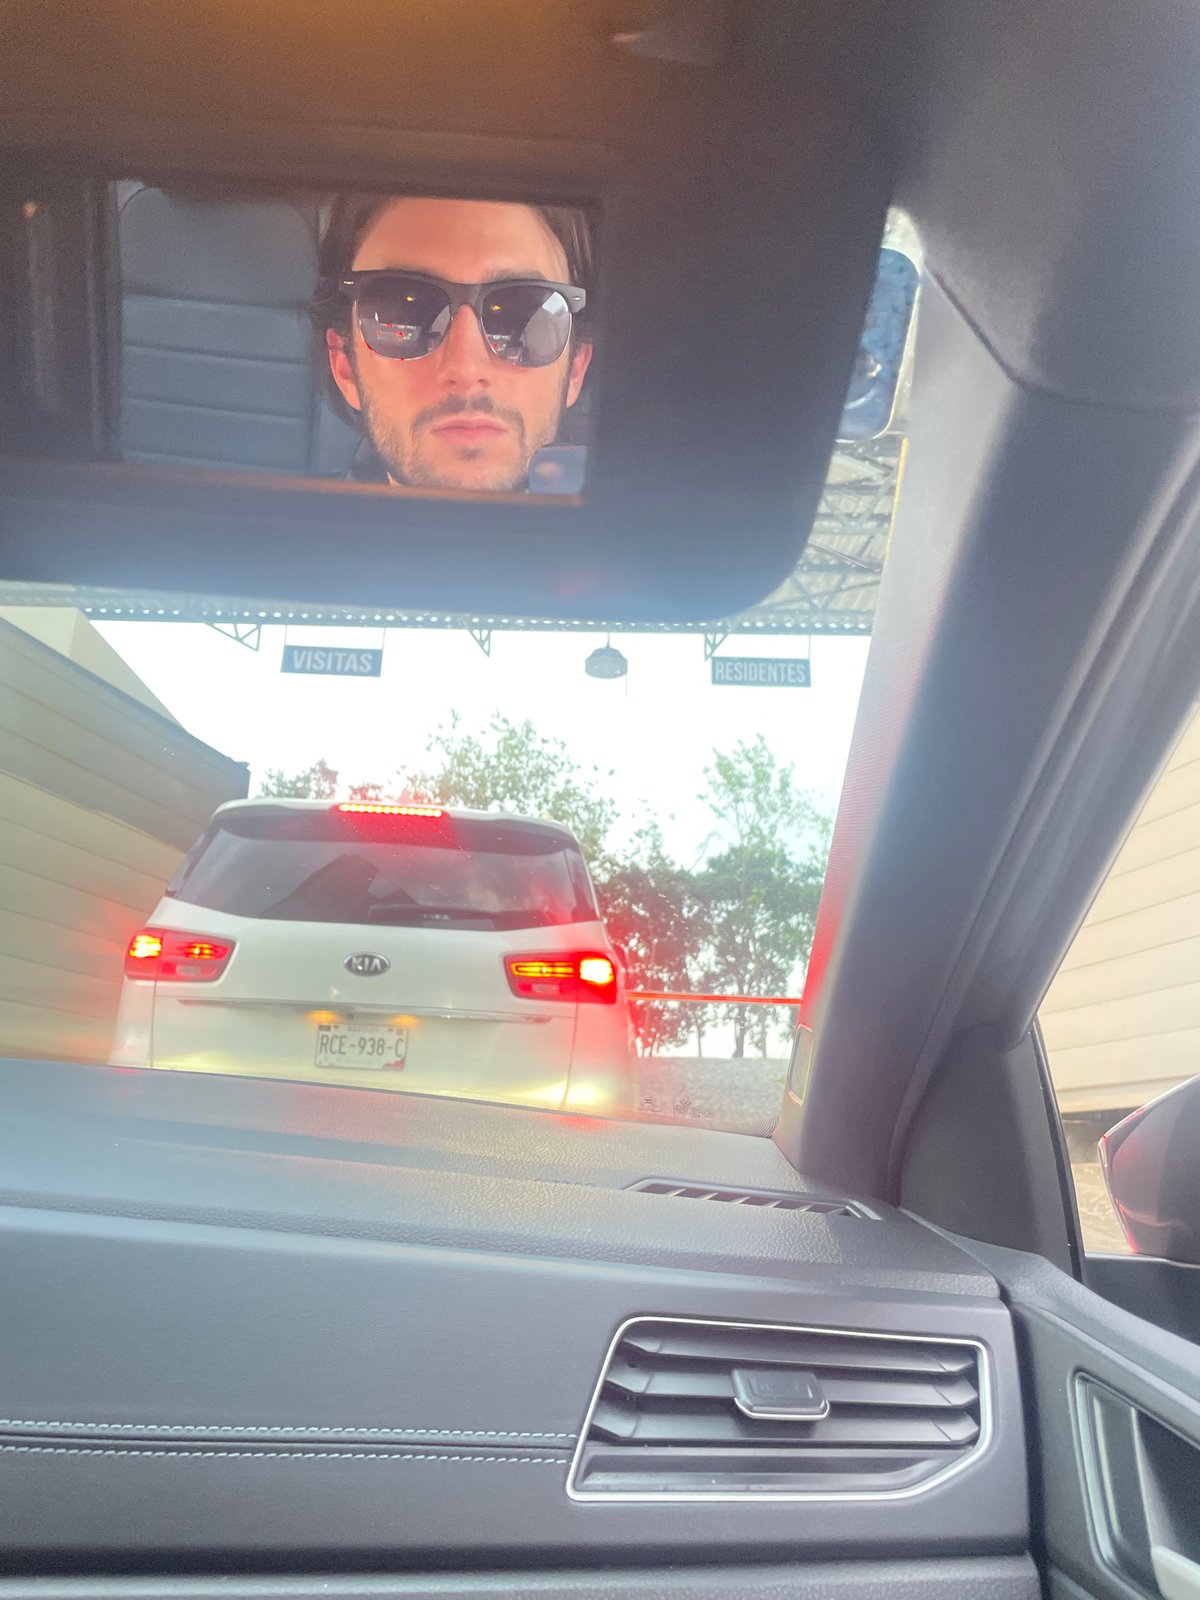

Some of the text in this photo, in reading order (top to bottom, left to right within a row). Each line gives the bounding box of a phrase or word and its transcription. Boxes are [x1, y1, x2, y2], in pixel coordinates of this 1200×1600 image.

[293, 650, 373, 673] VISITAS
[715, 661, 806, 683] RESIDENTES
[352, 957, 381, 971] KIA
[319, 1034, 404, 1058] RCE-938-C
